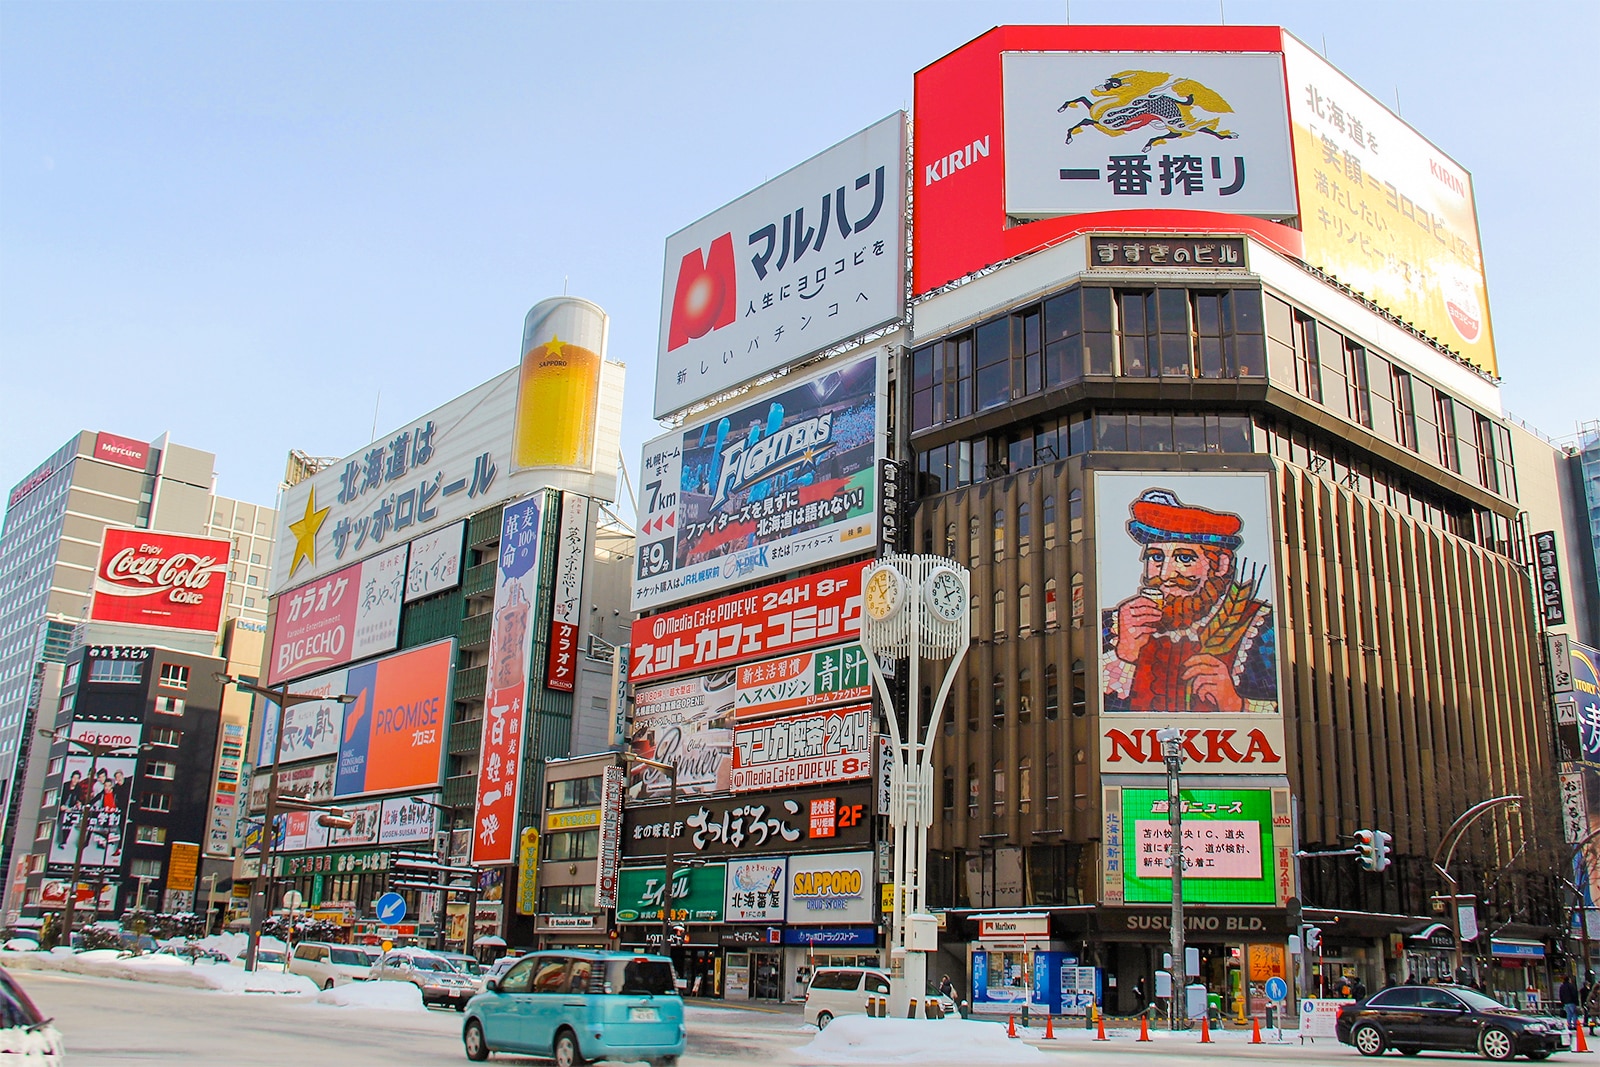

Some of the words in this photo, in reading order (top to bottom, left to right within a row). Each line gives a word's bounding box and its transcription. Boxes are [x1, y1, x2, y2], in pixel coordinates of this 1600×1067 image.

[1303, 84, 1377, 155] 北海道を
[925, 134, 990, 186] KIRIN
[1060, 154, 1246, 196] 一番搾り
[1428, 158, 1465, 200] KIRIN
[749, 167, 886, 284] マルハン
[1097, 243, 1237, 264] すすきのビル
[746, 240, 885, 318] 人生にヨロコビを
[676, 291, 869, 385] 新しいパチンコへ
[538, 360, 568, 369] SAPPORO
[102, 443, 142, 459] Mercure
[336, 420, 437, 505] 北海道は
[646, 446, 682, 473] 札幌ドーム
[656, 464, 669, 480] まで
[711, 415, 834, 514] FIGHTERS
[331, 451, 498, 560] サッポロビール
[686, 490, 799, 543] ファイターズを見ずに
[139, 543, 162, 555] Enjoy
[503, 514, 520, 568] 革命
[771, 545, 791, 563] または
[793, 535, 834, 557] ファイターズ
[107, 547, 216, 589] Coca-Cola
[1537, 533, 1562, 620] すすきのビル
[169, 588, 204, 605] Coke
[287, 578, 349, 624] カラオケ
[666, 614, 693, 636] Media
[694, 610, 715, 629] Cafe
[717, 596, 759, 623] POPEYE
[763, 588, 811, 612] 24H
[817, 578, 849, 598] 8F
[277, 639, 305, 673] BIG
[305, 625, 346, 657] ECHO
[556, 625, 573, 678] カラオケ
[631, 624, 763, 678] ネットカフェ
[738, 678, 811, 704] ヘスペリジン
[742, 657, 801, 685] 新生活習慣
[817, 650, 867, 691] 青汁
[376, 697, 439, 736] PROMISE
[616, 681, 626, 735] グリーンビル
[806, 694, 829, 706] ドリーム
[832, 688, 868, 699] ファクトリー
[78, 731, 132, 744] docomo
[411, 729, 436, 748] プロミス
[503, 698, 520, 799] 本格麦焼酎
[826, 712, 869, 755] 24H
[1104, 728, 1281, 765] NIKKA
[480, 704, 510, 847] 百姓一揆
[745, 768, 771, 786] Media
[774, 766, 795, 783] Cafe
[797, 760, 838, 780] POPEYE
[842, 757, 868, 774] 8F
[62, 811, 121, 826] ドコの学割
[686, 799, 800, 850] さっぽろっこ
[809, 800, 835, 815] 炭火焼き
[838, 804, 863, 827] 2F
[1273, 816, 1291, 825] uhb
[1106, 813, 1120, 872] 北海道新聞
[1143, 857, 1215, 869] 新年も着工
[793, 870, 862, 896] SAPPORO
[1279, 848, 1290, 905] 道新スポーツ
[806, 899, 823, 910] DRUG
[825, 899, 848, 910] STORE
[1226, 917, 1267, 932] BLD.
[995, 922, 1017, 931] Marlboro
